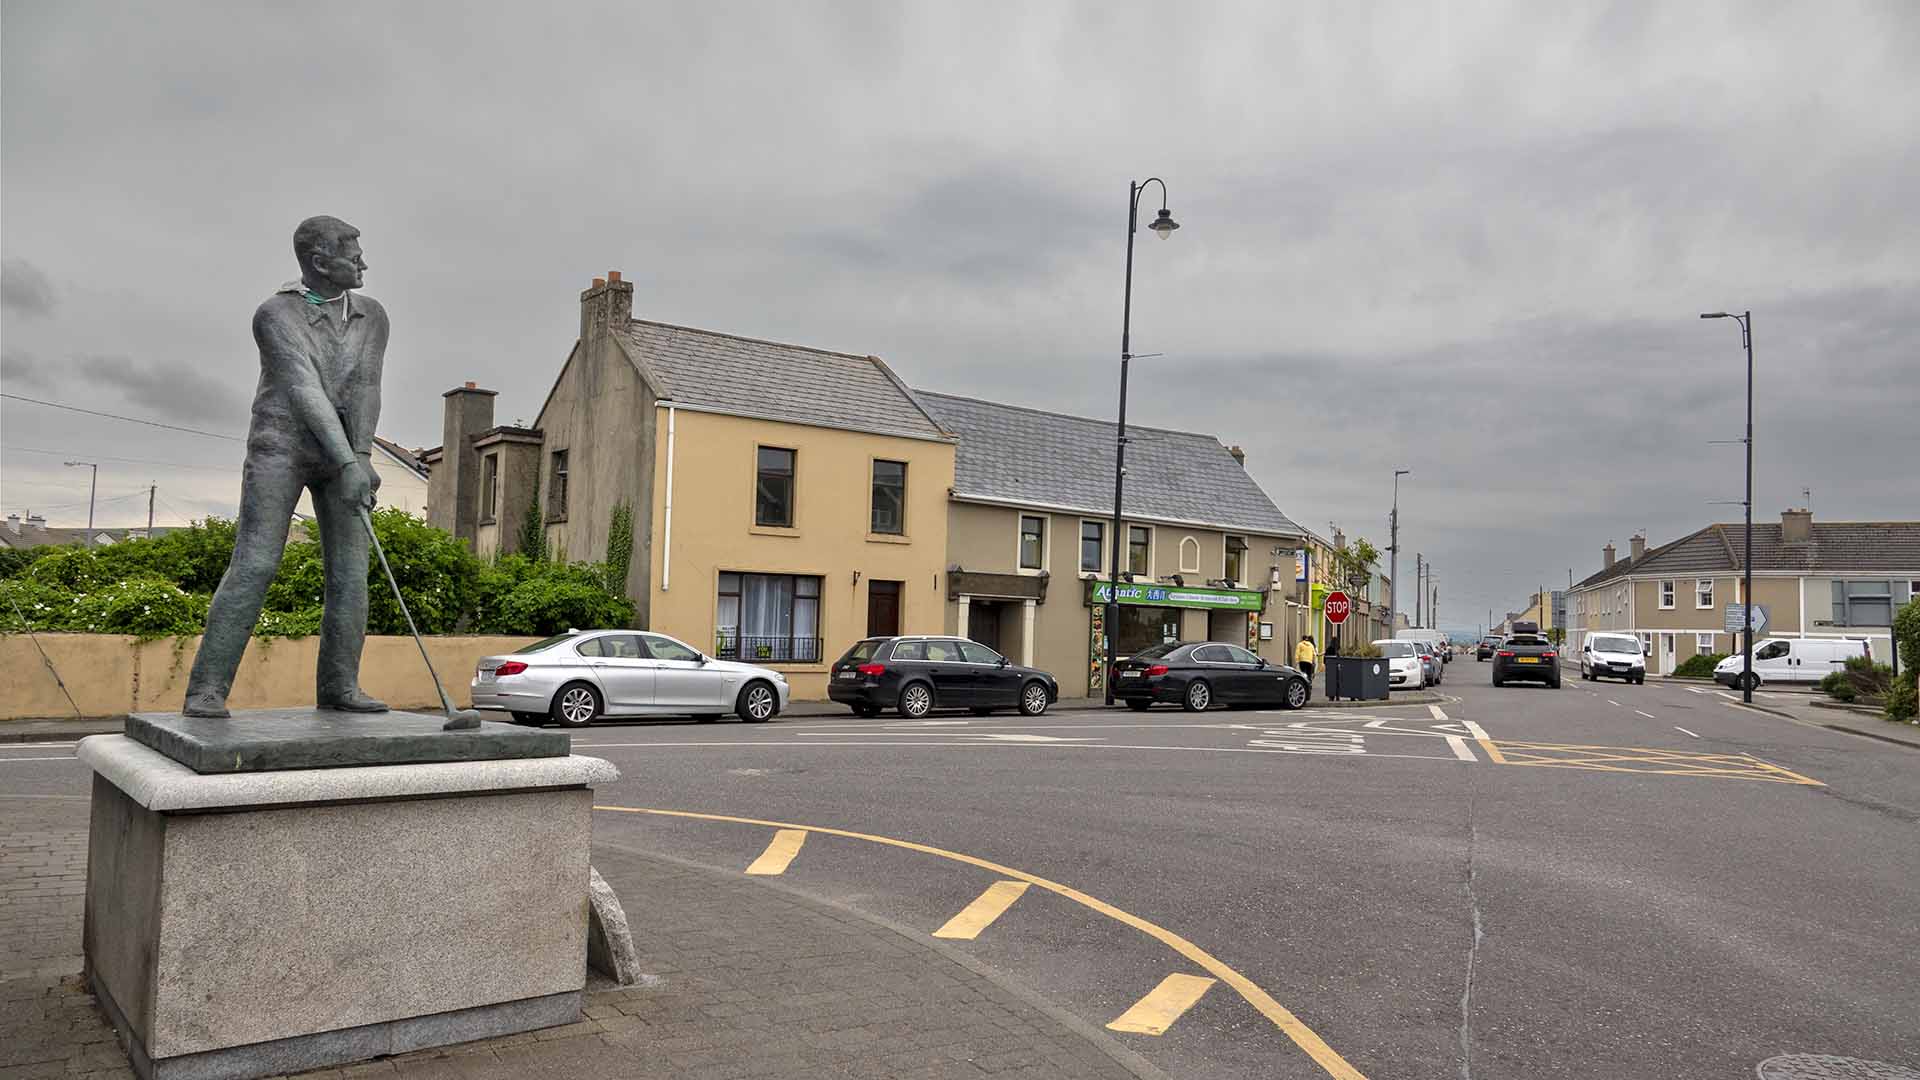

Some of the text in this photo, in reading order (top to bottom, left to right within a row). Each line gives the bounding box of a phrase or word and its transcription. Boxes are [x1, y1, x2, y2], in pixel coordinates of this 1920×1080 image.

[1096, 584, 1142, 602] Atntic
[1327, 601, 1348, 614] STOP
[1246, 731, 1367, 754] STOP
